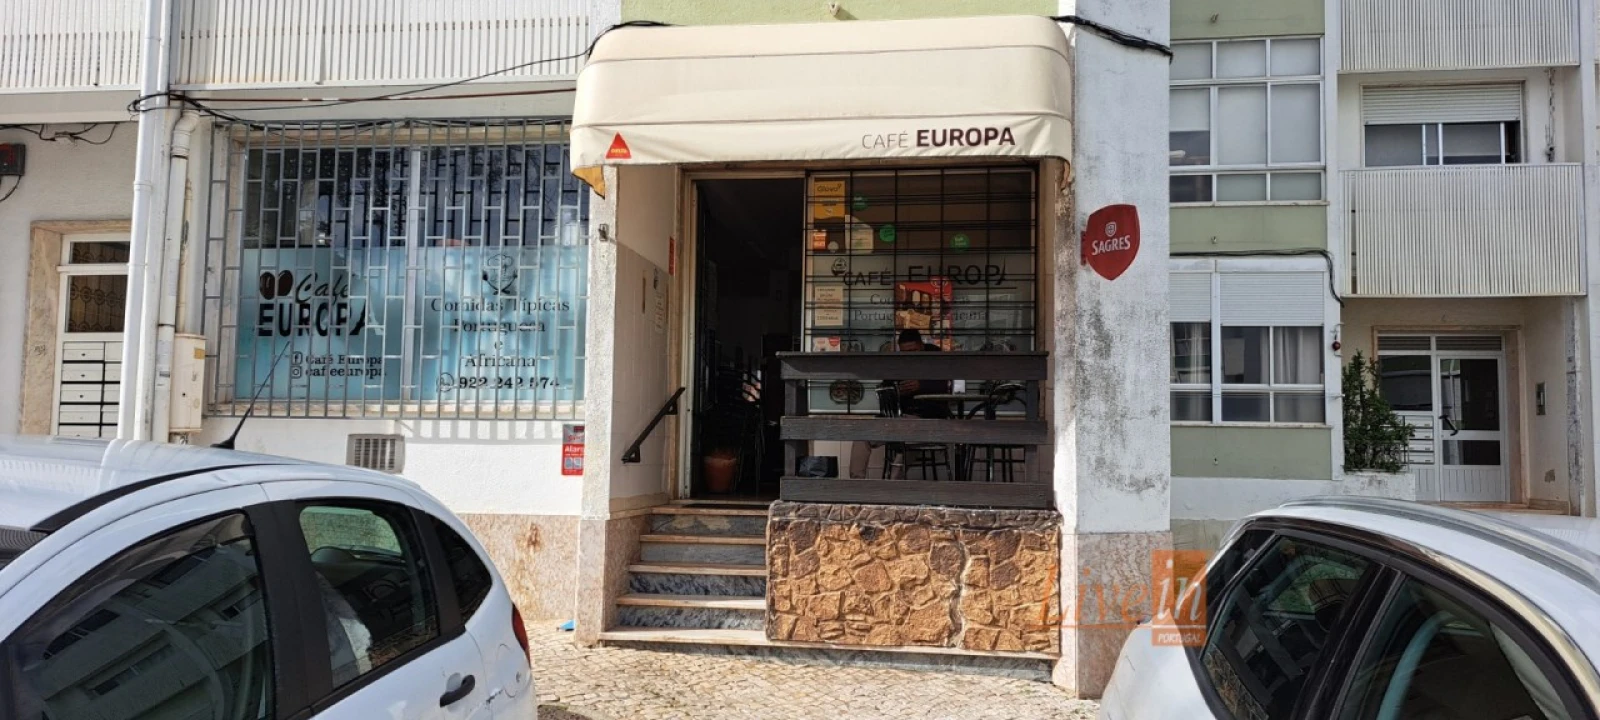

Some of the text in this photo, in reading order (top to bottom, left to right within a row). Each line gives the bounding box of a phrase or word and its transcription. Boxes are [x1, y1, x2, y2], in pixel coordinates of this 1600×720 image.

[862, 127, 1016, 149] CAFÉ EUROPA
[1091, 235, 1131, 256] SAGRES
[843, 267, 892, 286] CAFÉ
[295, 271, 355, 305] Café
[431, 298, 570, 315] Comidas Típicas
[258, 303, 385, 336] EUROPA
[453, 318, 546, 335] Portuguesa
[494, 341, 503, 350] e
[305, 354, 384, 368] Café Europa
[465, 353, 536, 367] Africana
[305, 367, 387, 379] cafeeuropa
[459, 377, 488, 389] 922
